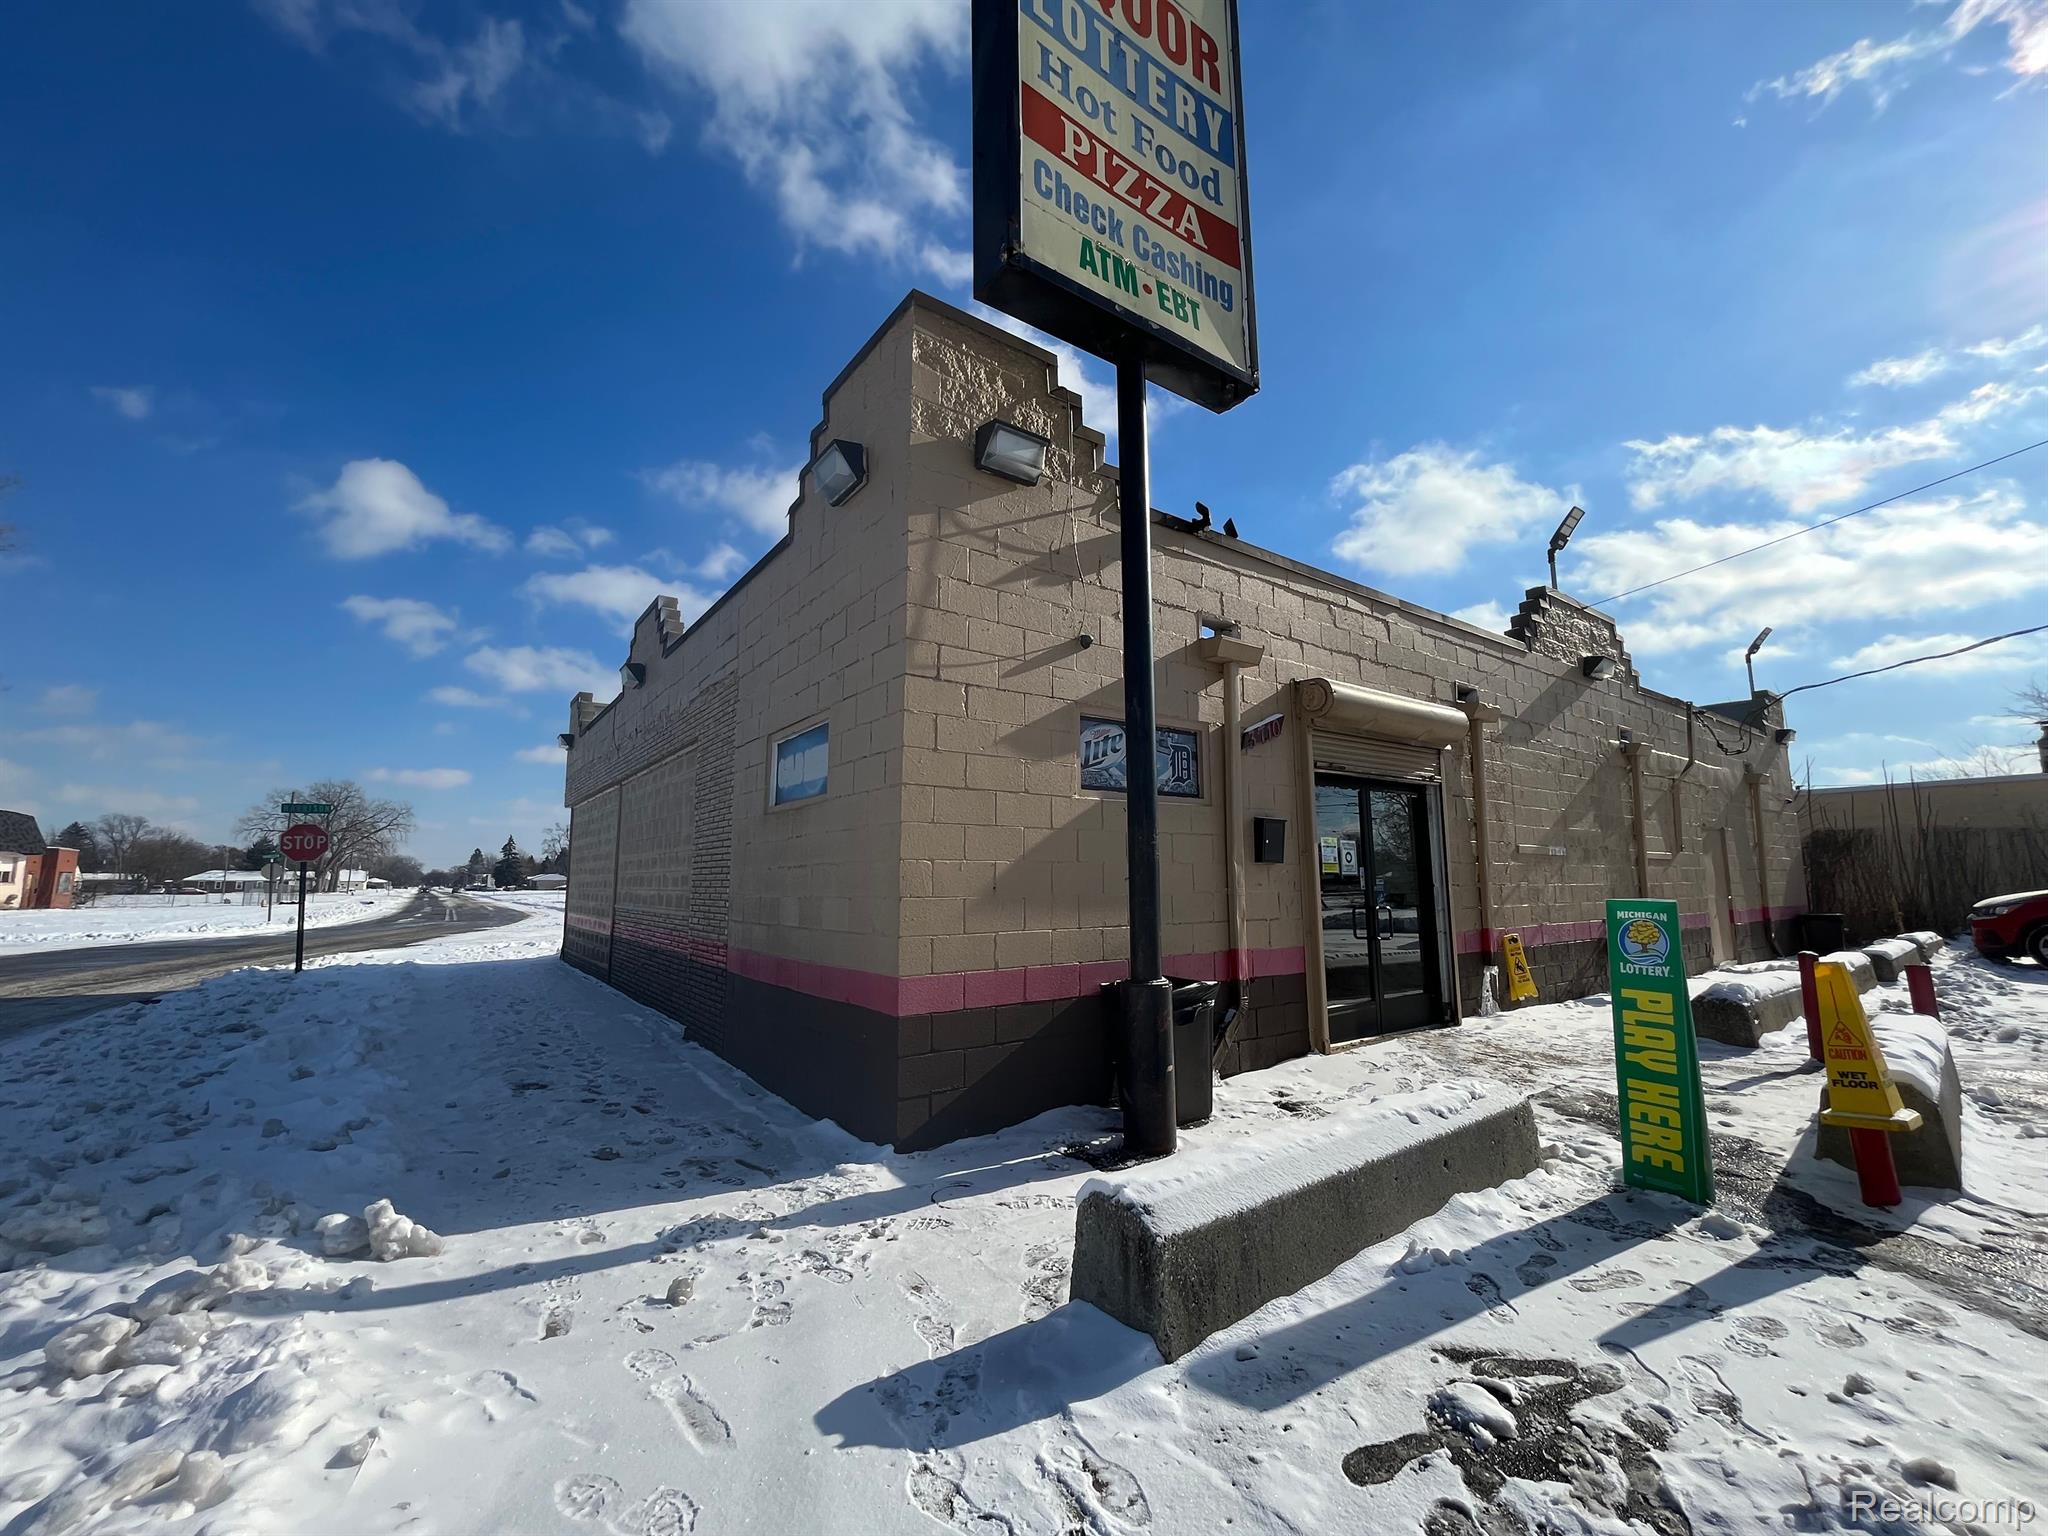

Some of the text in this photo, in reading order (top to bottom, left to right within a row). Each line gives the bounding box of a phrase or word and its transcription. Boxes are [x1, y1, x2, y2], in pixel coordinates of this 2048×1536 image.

[1033, 0, 1222, 151] LOTTERY
[1098, 0, 1221, 95] UOR
[1036, 40, 1223, 206] Hot Food
[1060, 115, 1208, 250] PIZZA
[1033, 158, 1233, 312] Check Cashing
[1079, 236, 1201, 331] ATM EBT
[1081, 733, 1123, 769] Lite
[283, 836, 327, 850] STOP
[1616, 910, 1667, 922] MICHIGAN
[1619, 962, 1671, 977] LOTTERY
[1621, 988, 1678, 1075] PLAY
[1828, 1047, 1868, 1061] CAUTION
[1832, 1079, 1880, 1090] FLOOR
[1837, 1071, 1869, 1081] WET
[1626, 1077, 1684, 1173] HERE
